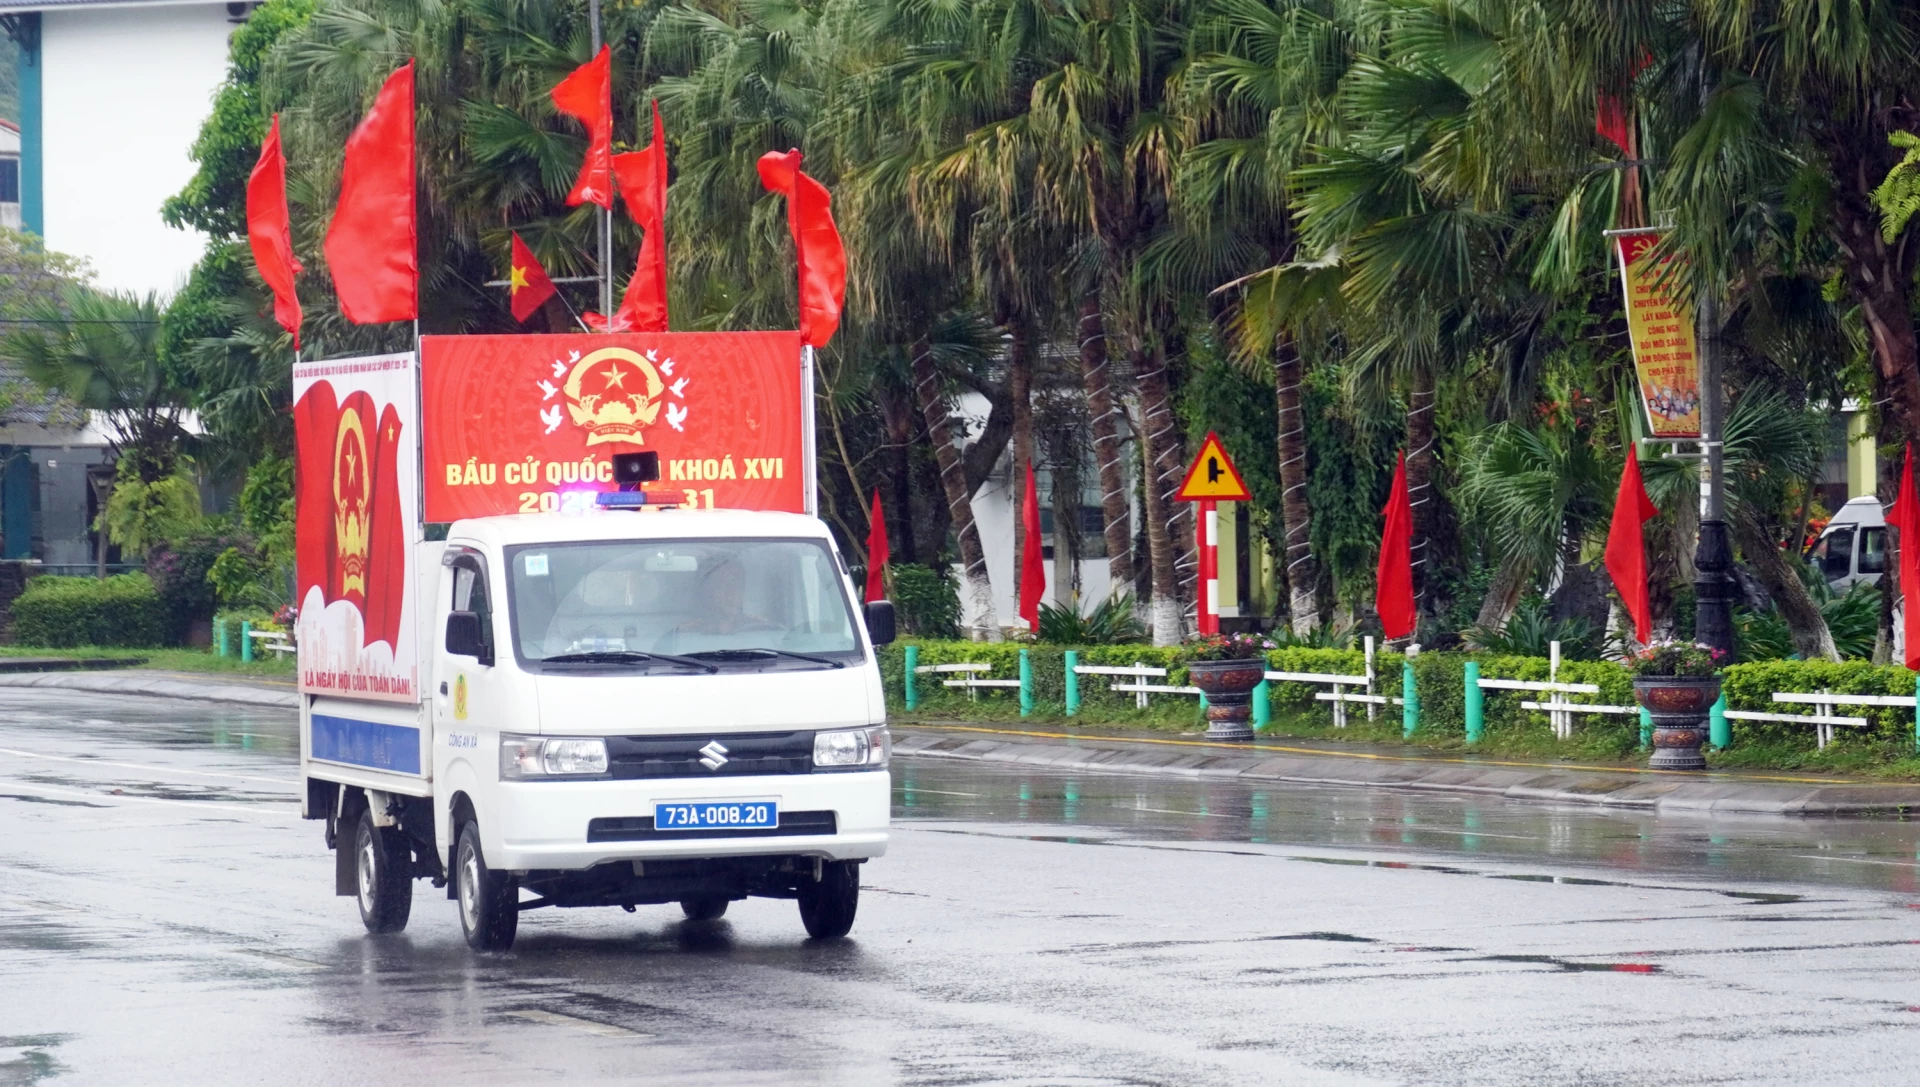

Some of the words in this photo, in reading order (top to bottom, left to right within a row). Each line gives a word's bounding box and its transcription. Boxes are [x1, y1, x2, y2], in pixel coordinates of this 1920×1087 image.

[446, 456, 497, 486] BẦU
[504, 455, 541, 484] CỬ
[545, 453, 613, 486] QUỐC
[669, 454, 737, 481] KHOÁ
[743, 457, 783, 480] XVI
[665, 805, 768, 825] 73A-008.20
